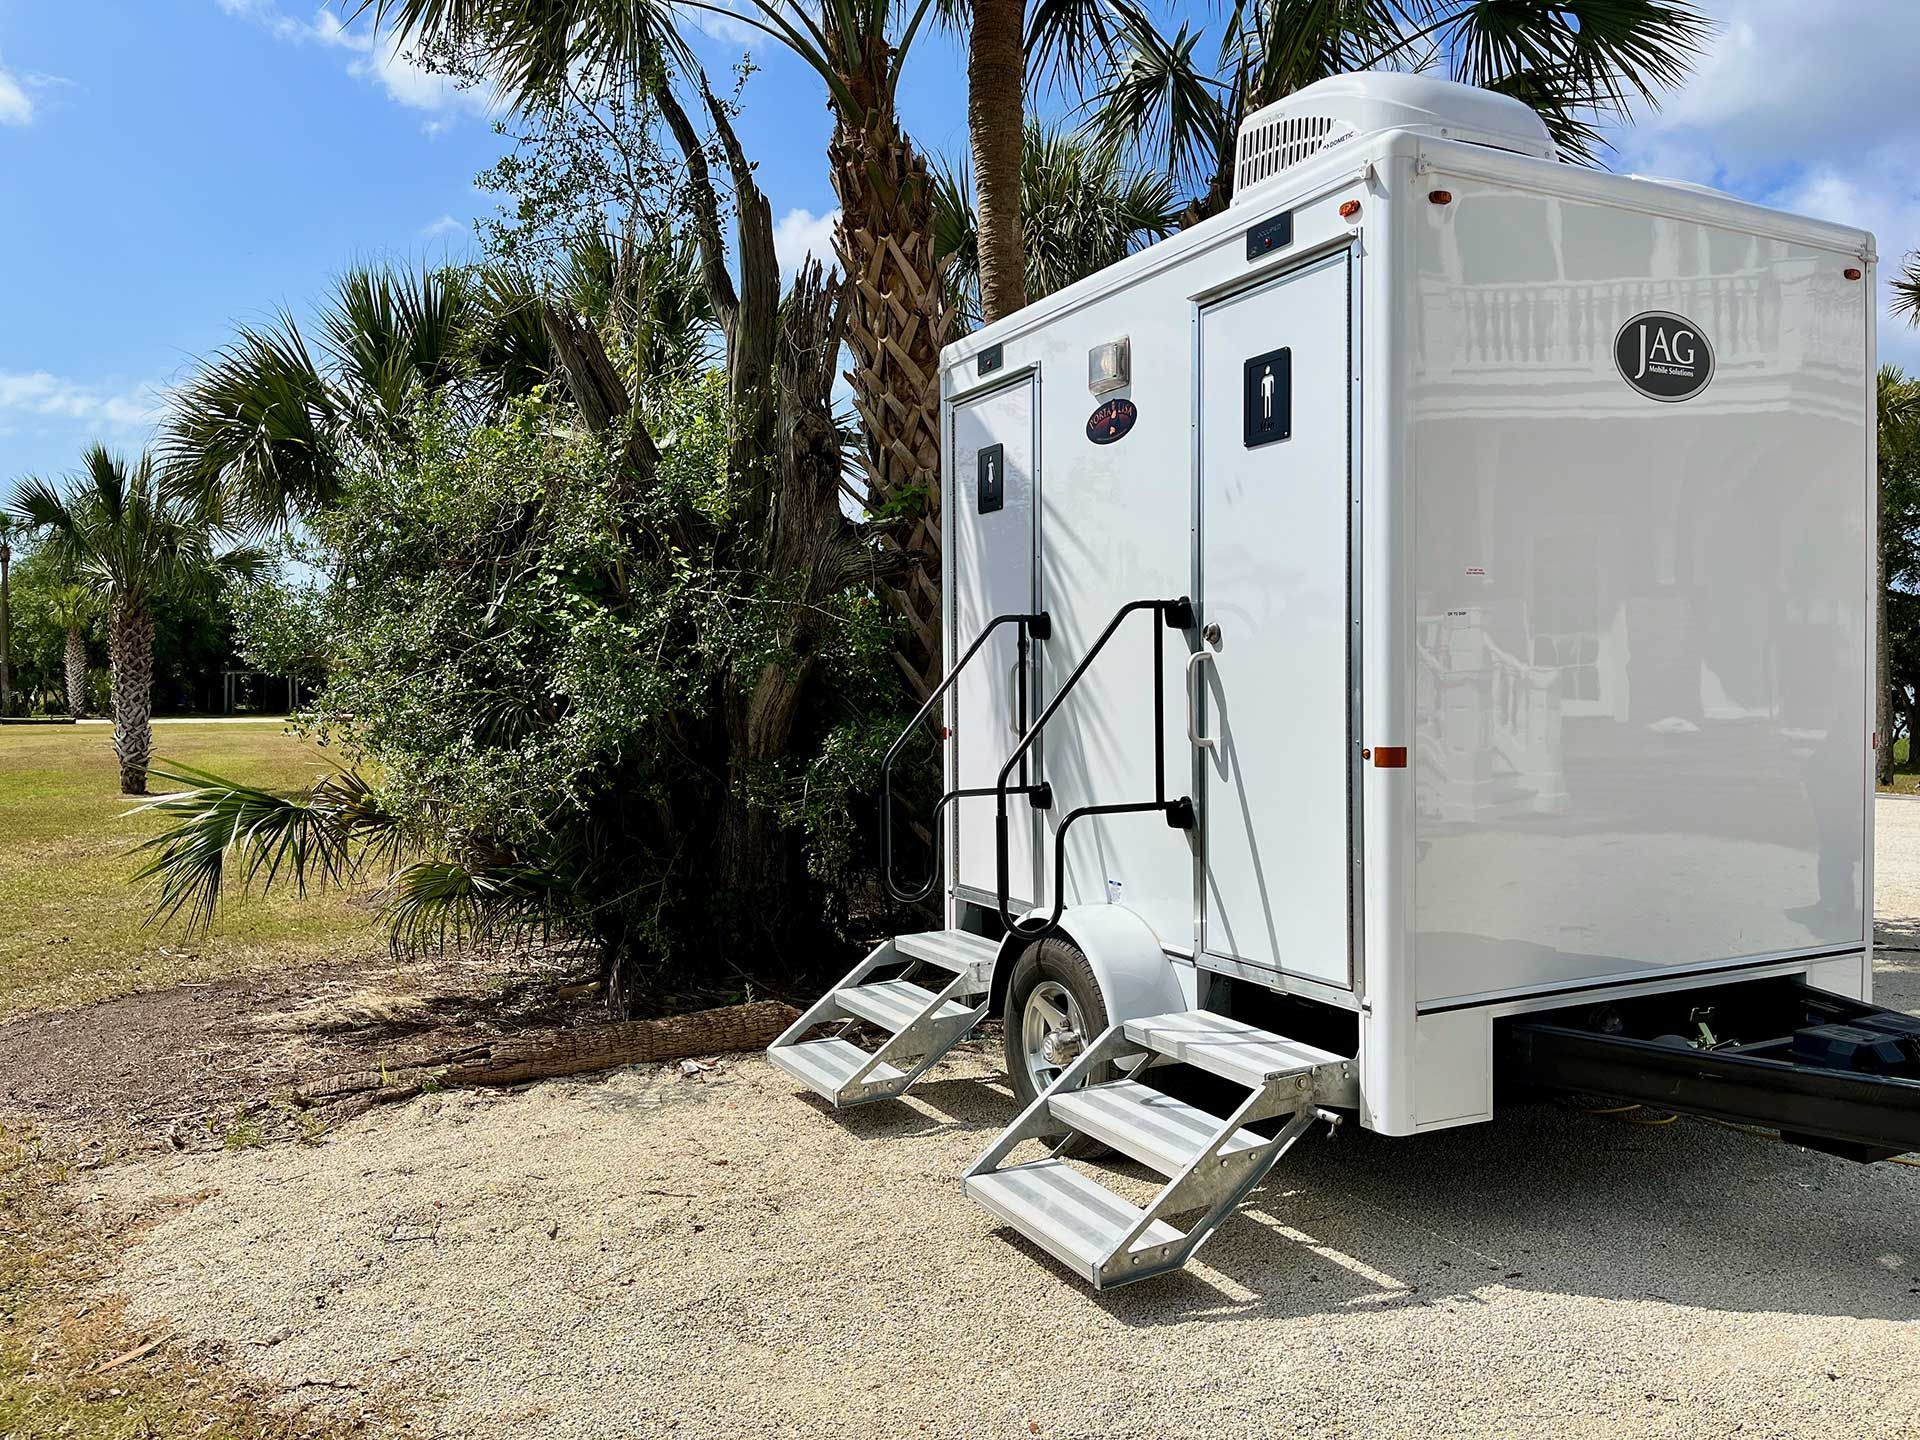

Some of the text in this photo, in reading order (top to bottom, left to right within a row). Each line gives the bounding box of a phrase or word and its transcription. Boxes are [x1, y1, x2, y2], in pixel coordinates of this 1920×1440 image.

[1329, 131, 1354, 148] DOMETIC
[1634, 324, 1695, 379] JAG
[1648, 365, 1694, 378] Mobile Solutions
